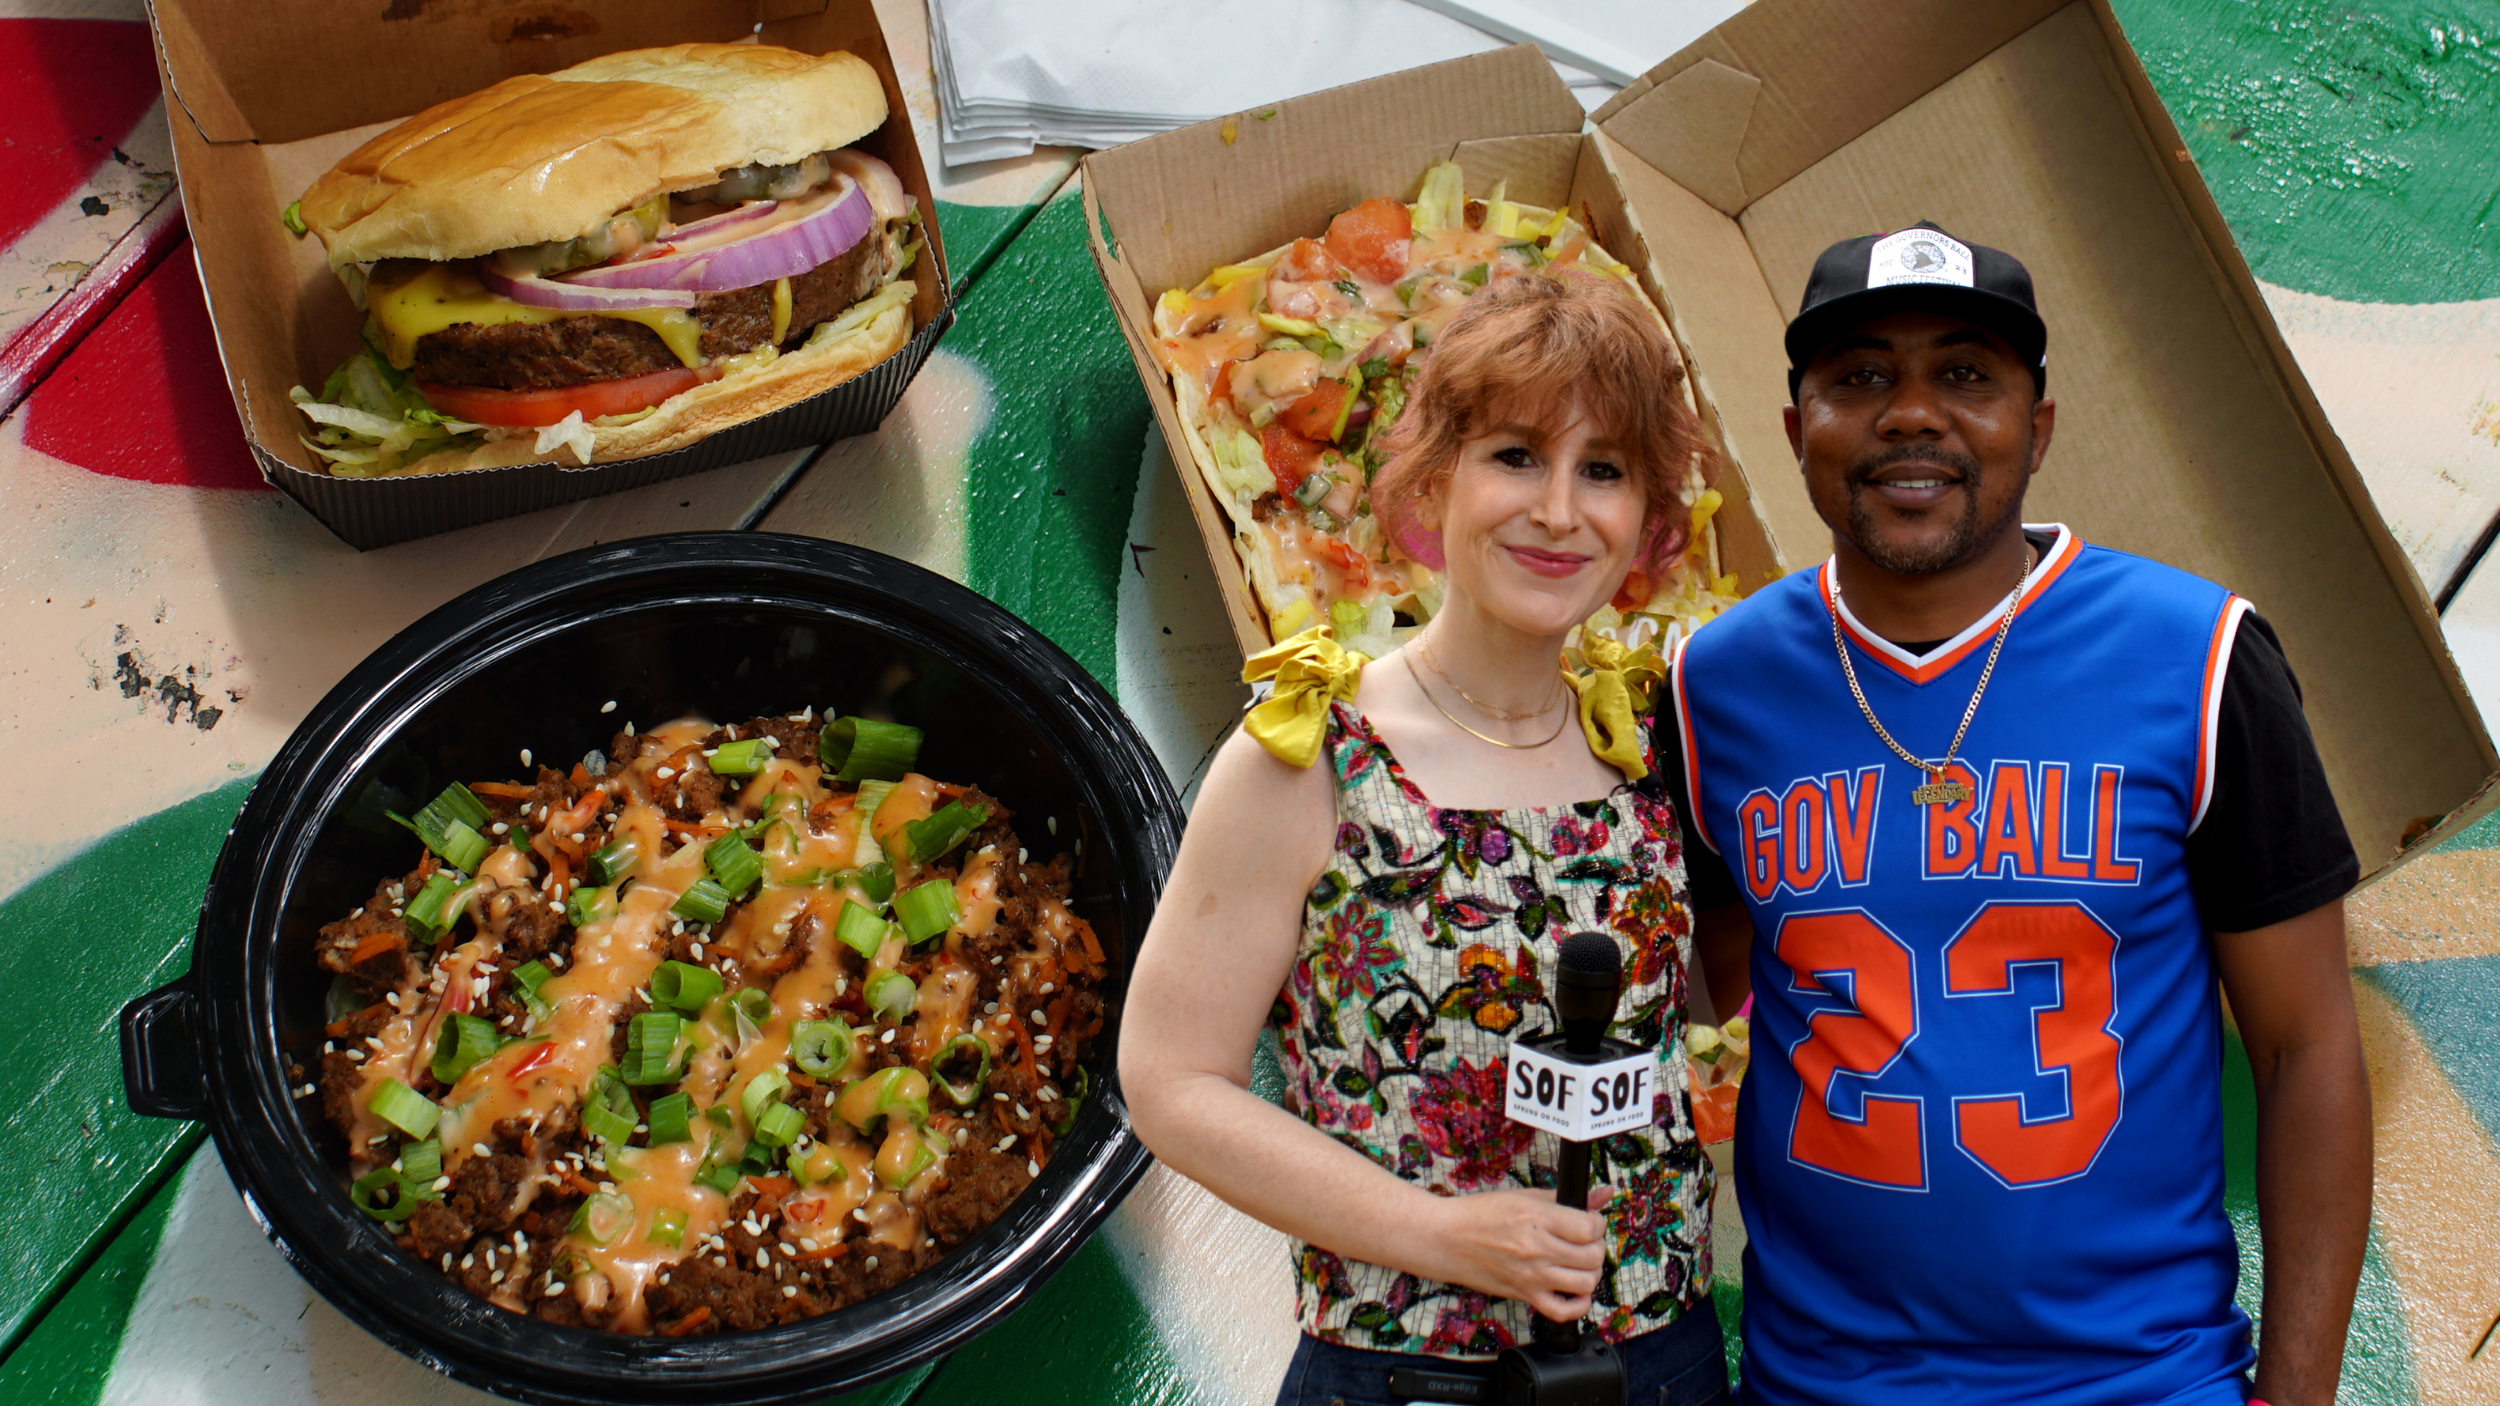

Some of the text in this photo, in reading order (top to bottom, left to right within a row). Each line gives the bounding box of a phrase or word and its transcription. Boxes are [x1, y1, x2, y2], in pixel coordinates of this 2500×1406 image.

[1876, 230, 1970, 261] THE GOVERNORS BALL
[1879, 259, 1894, 268] NYC
[1955, 265, 1967, 275] 23
[1886, 274, 1961, 285] MUSIC FESTIV
[1736, 758, 2142, 904] GOV BALL
[1774, 899, 2124, 1193] 23
[1513, 1059, 1576, 1112] SOF
[1590, 1066, 1649, 1116] SOF
[1513, 1104, 1570, 1128] SPRUNG ON FOOD
[1591, 1111, 1644, 1130] SPRUNG ON FOOD
